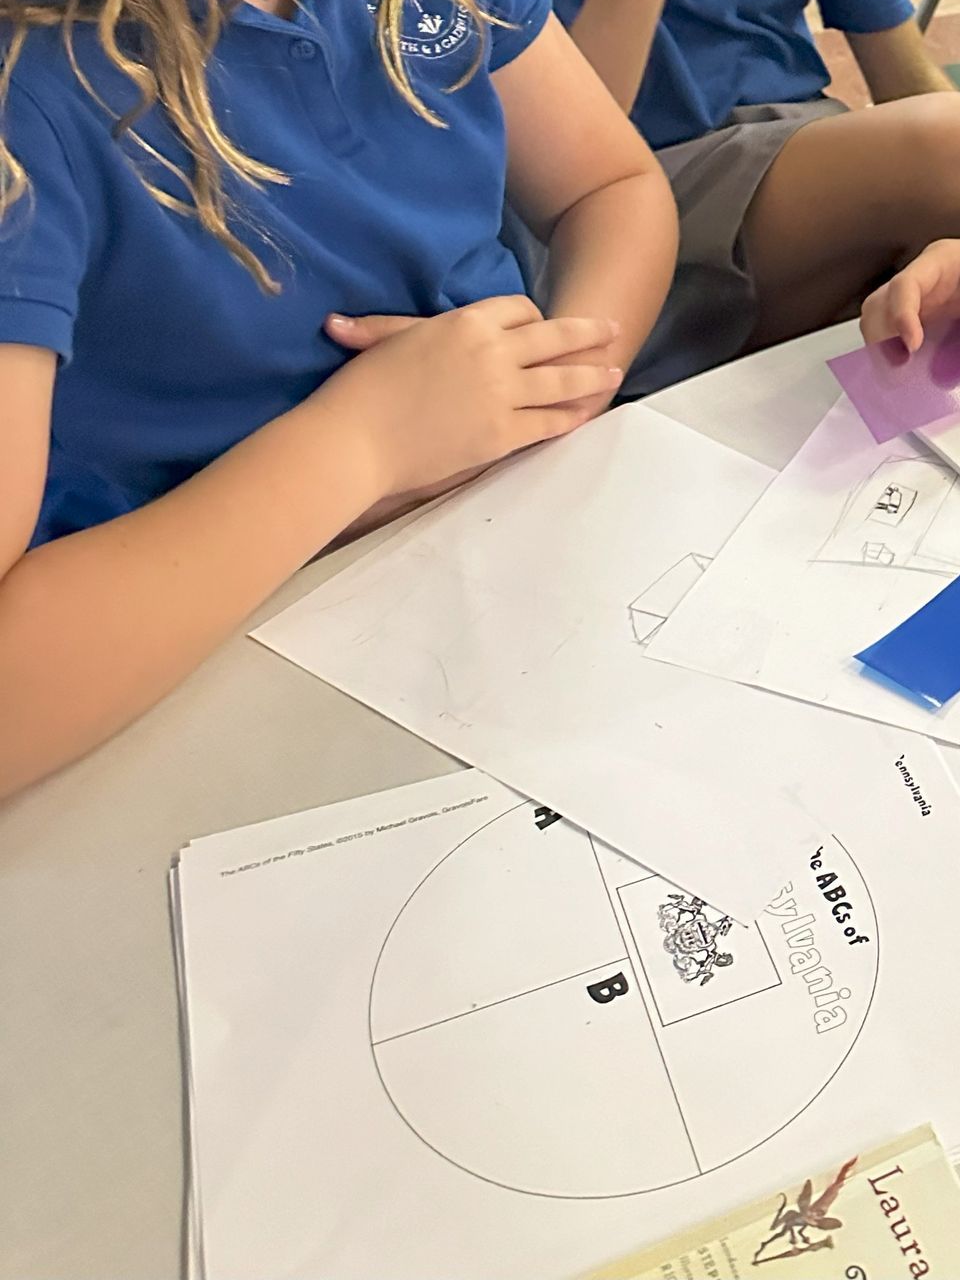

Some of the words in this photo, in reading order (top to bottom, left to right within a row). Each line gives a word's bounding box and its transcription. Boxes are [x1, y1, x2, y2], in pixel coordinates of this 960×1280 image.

[894, 754, 932, 817] ennsylvania
[220, 869, 237, 878] The
[272, 853, 286, 863] the
[287, 848, 305, 860] Fifty
[306, 841, 335, 853] States,
[376, 820, 407, 833] Michael
[815, 872, 853, 924] ABCs
[843, 926, 871, 946] of
[586, 971, 629, 1004] B
[867, 1165, 932, 1280] Laura
